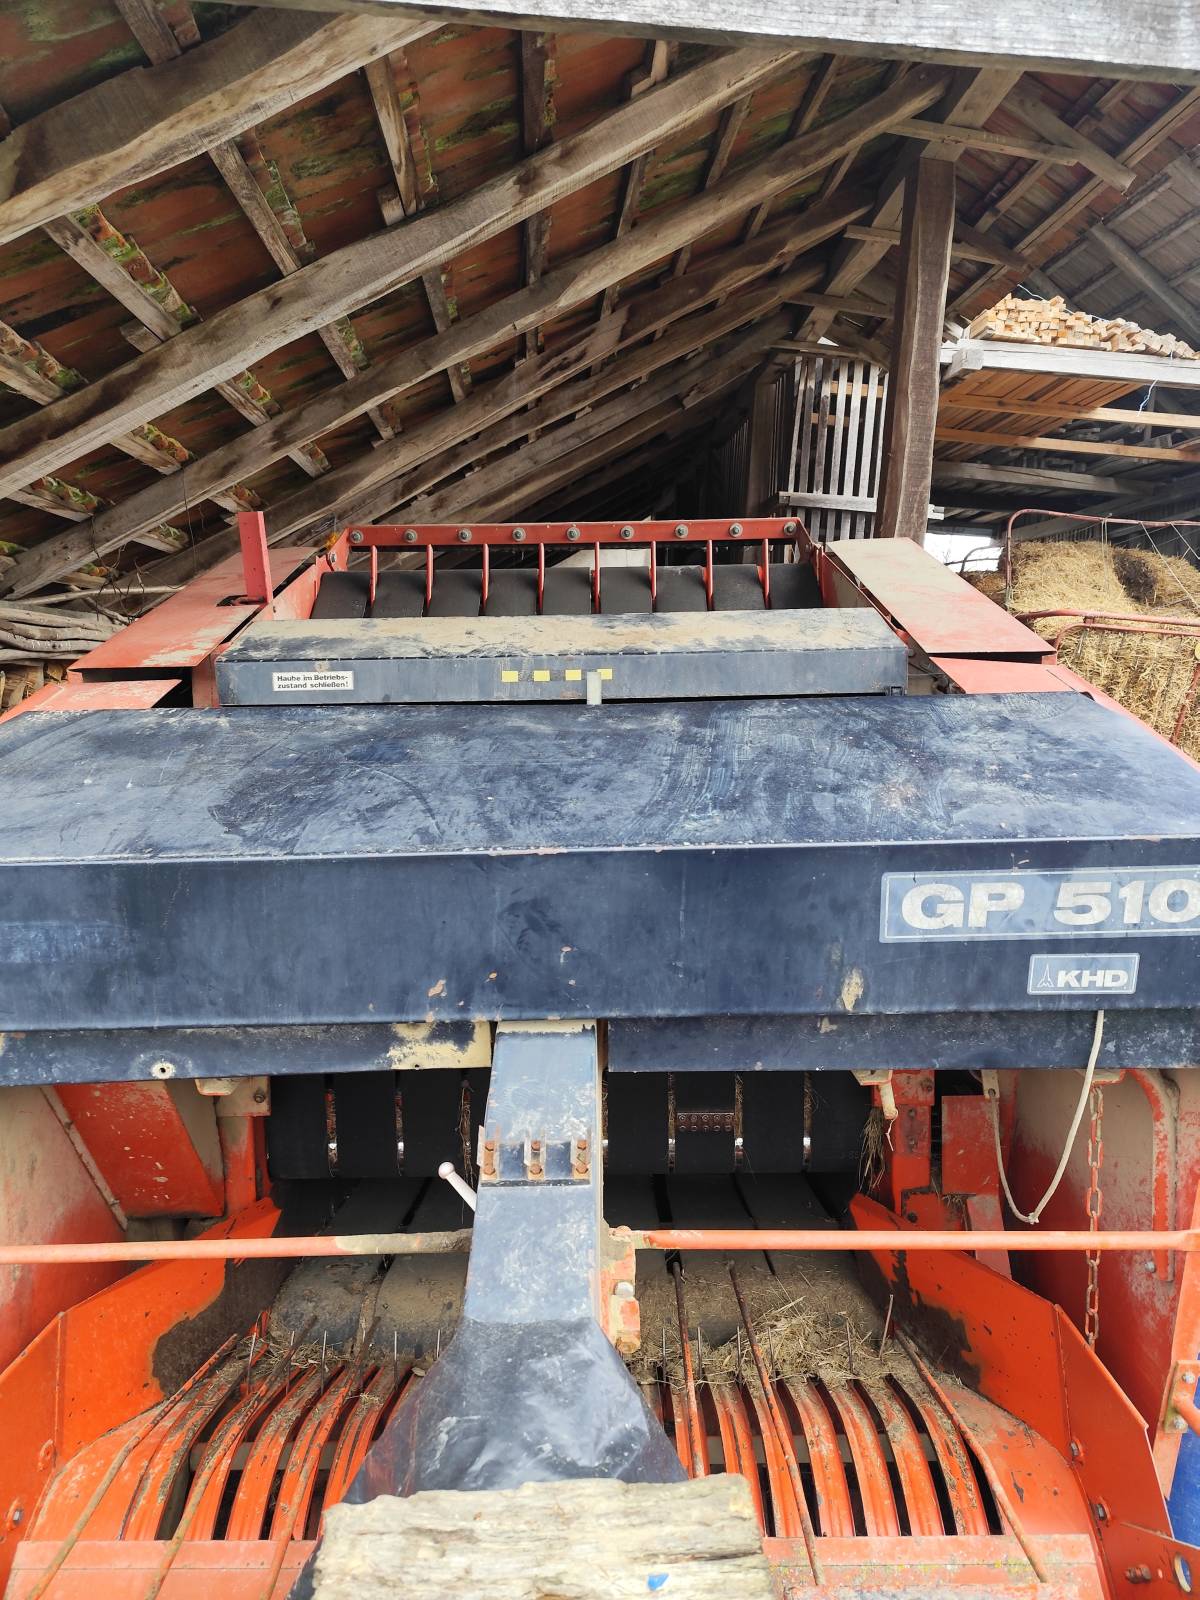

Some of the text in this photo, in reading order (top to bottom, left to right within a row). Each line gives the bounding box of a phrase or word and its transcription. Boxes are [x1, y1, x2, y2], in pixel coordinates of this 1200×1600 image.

[901, 878, 1200, 930] GP 510
[1057, 969, 1128, 988] KHD
